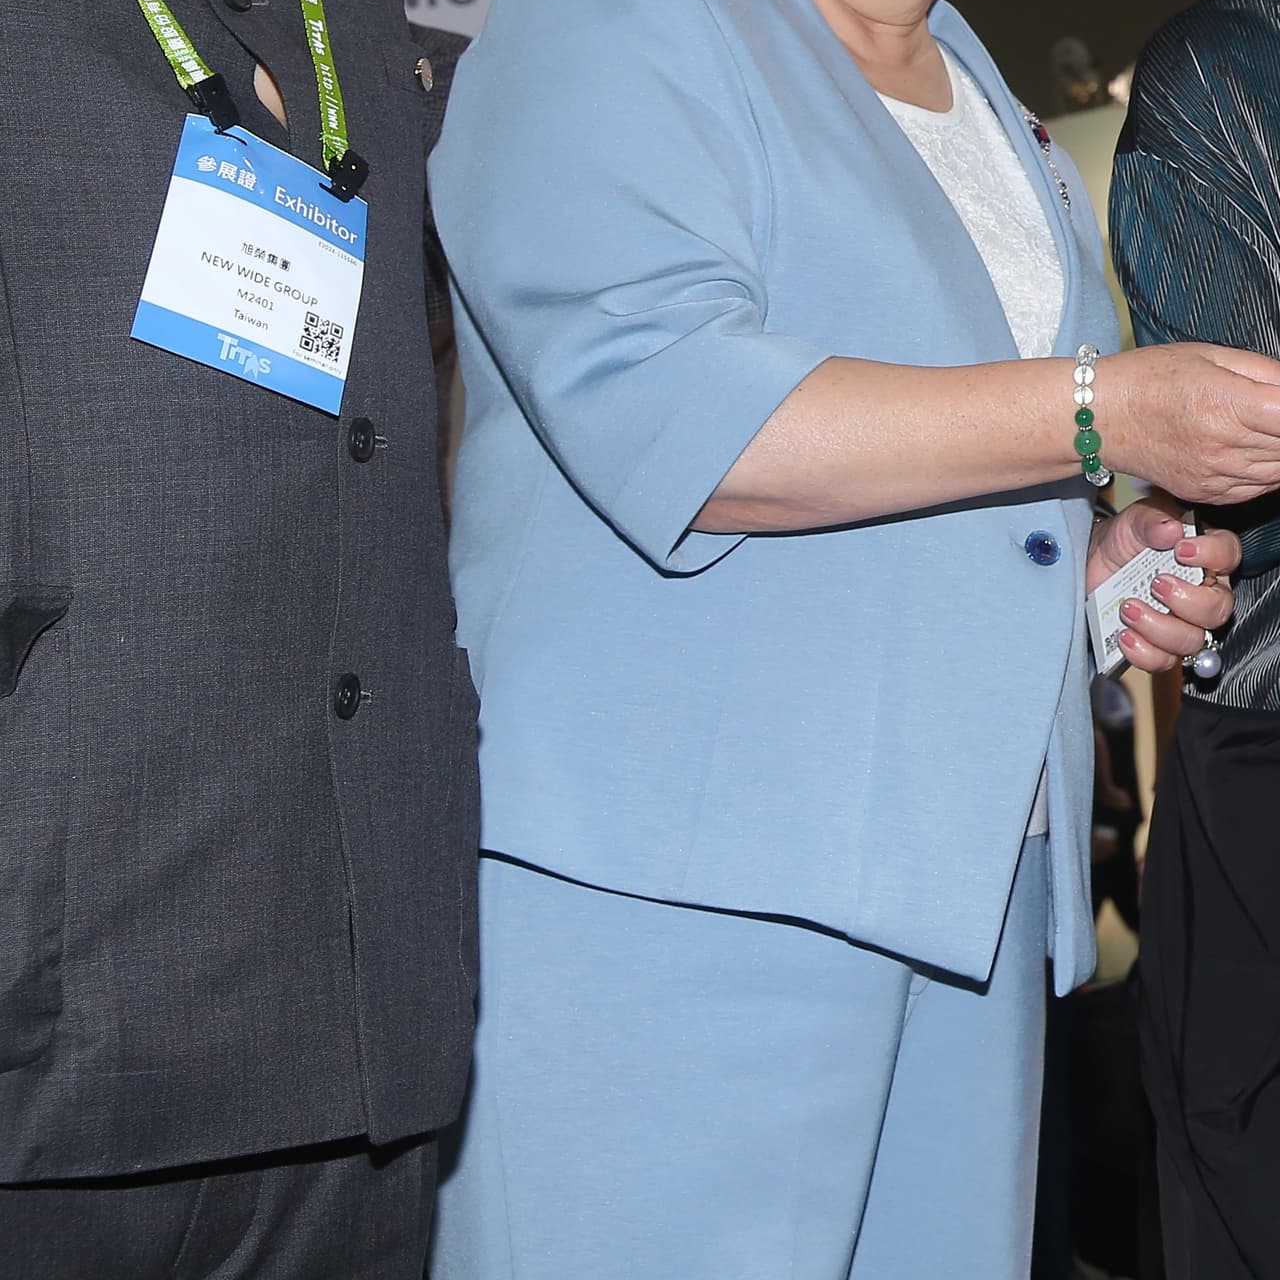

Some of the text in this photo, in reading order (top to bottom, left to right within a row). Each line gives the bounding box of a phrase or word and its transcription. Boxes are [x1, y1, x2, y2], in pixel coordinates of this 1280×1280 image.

[195, 155, 258, 192] 參展證
[273, 185, 358, 245] Exhibitor
[200, 251, 319, 308] NEW WIDE GROUP
[236, 287, 275, 311] M2401
[233, 308, 269, 331] Taiwan
